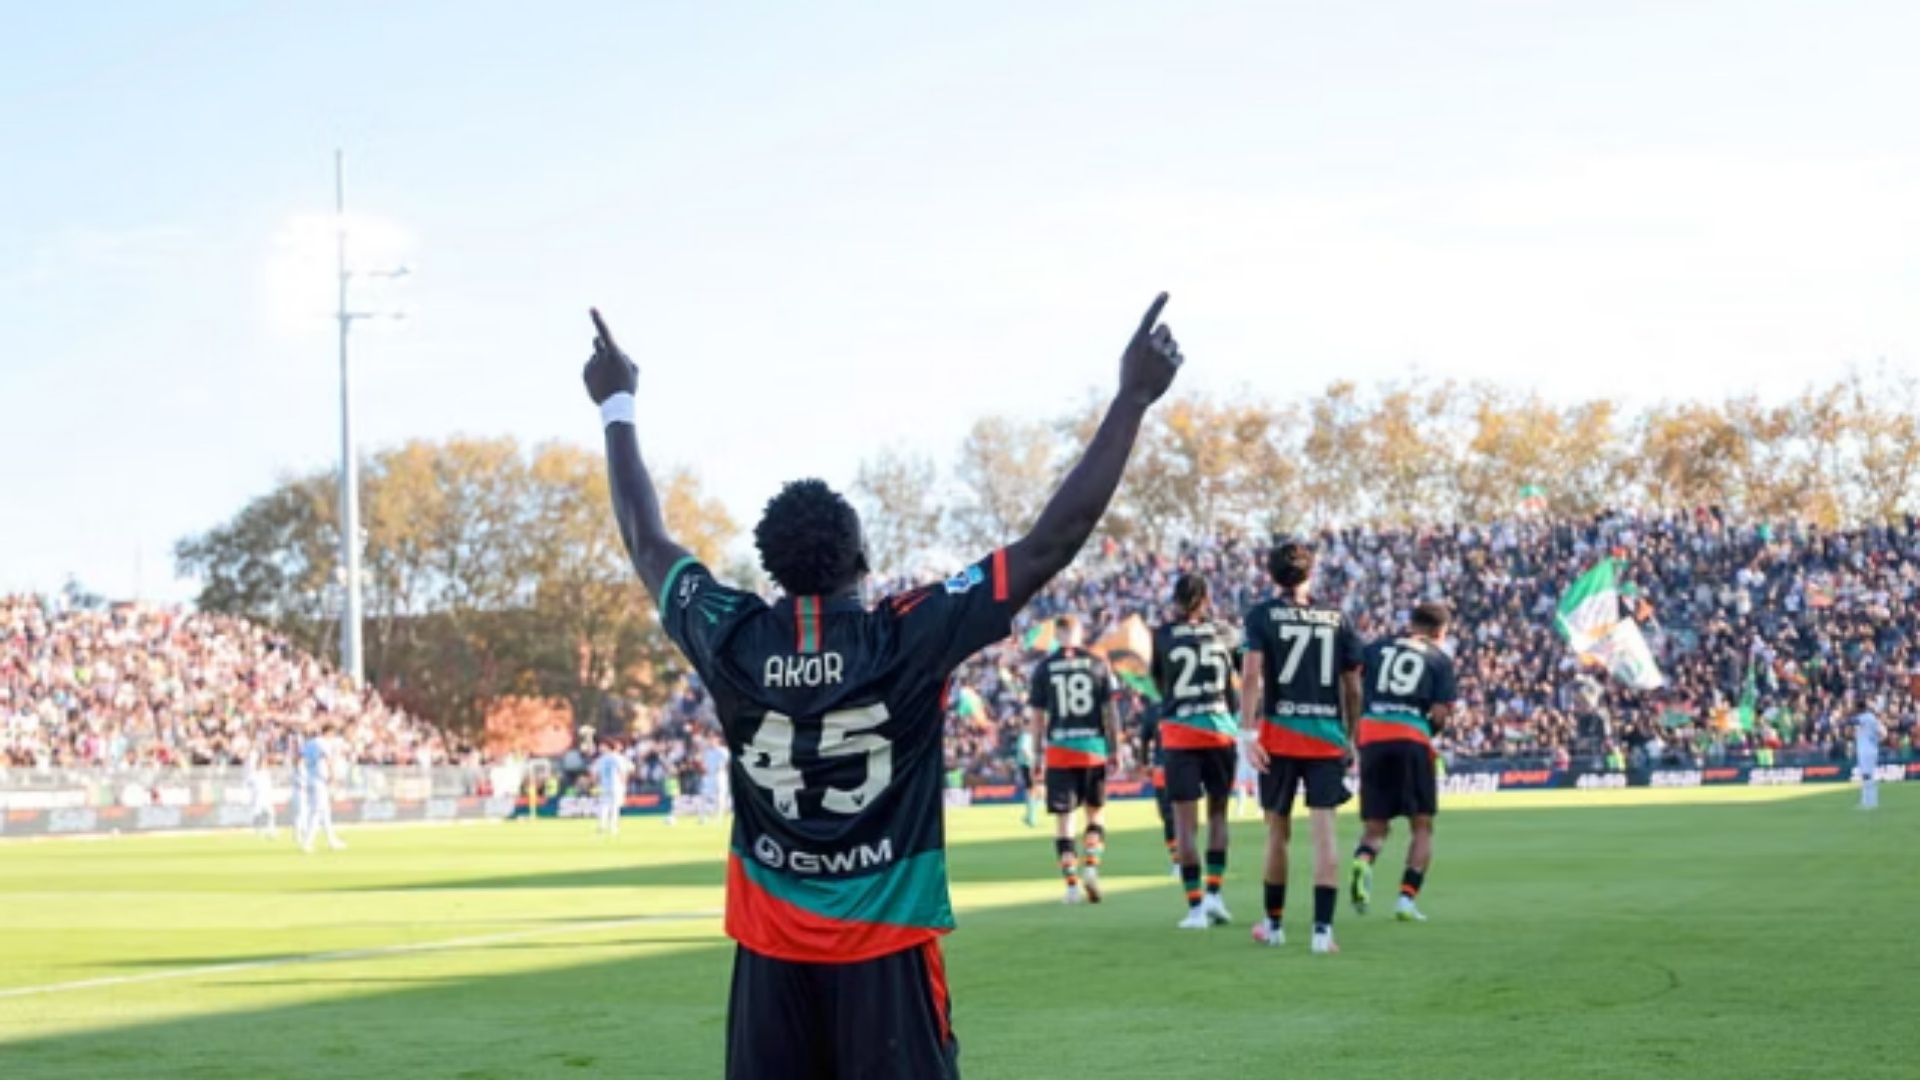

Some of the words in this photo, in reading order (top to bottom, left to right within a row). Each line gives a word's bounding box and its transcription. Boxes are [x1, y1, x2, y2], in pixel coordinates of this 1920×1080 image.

[763, 652, 845, 688] AKOR
[1169, 642, 1228, 698] 25
[1278, 624, 1335, 686] 71
[1377, 645, 1425, 695] 19
[1050, 673, 1094, 717] 18
[738, 702, 894, 820] 45
[788, 837, 894, 874] GWM
